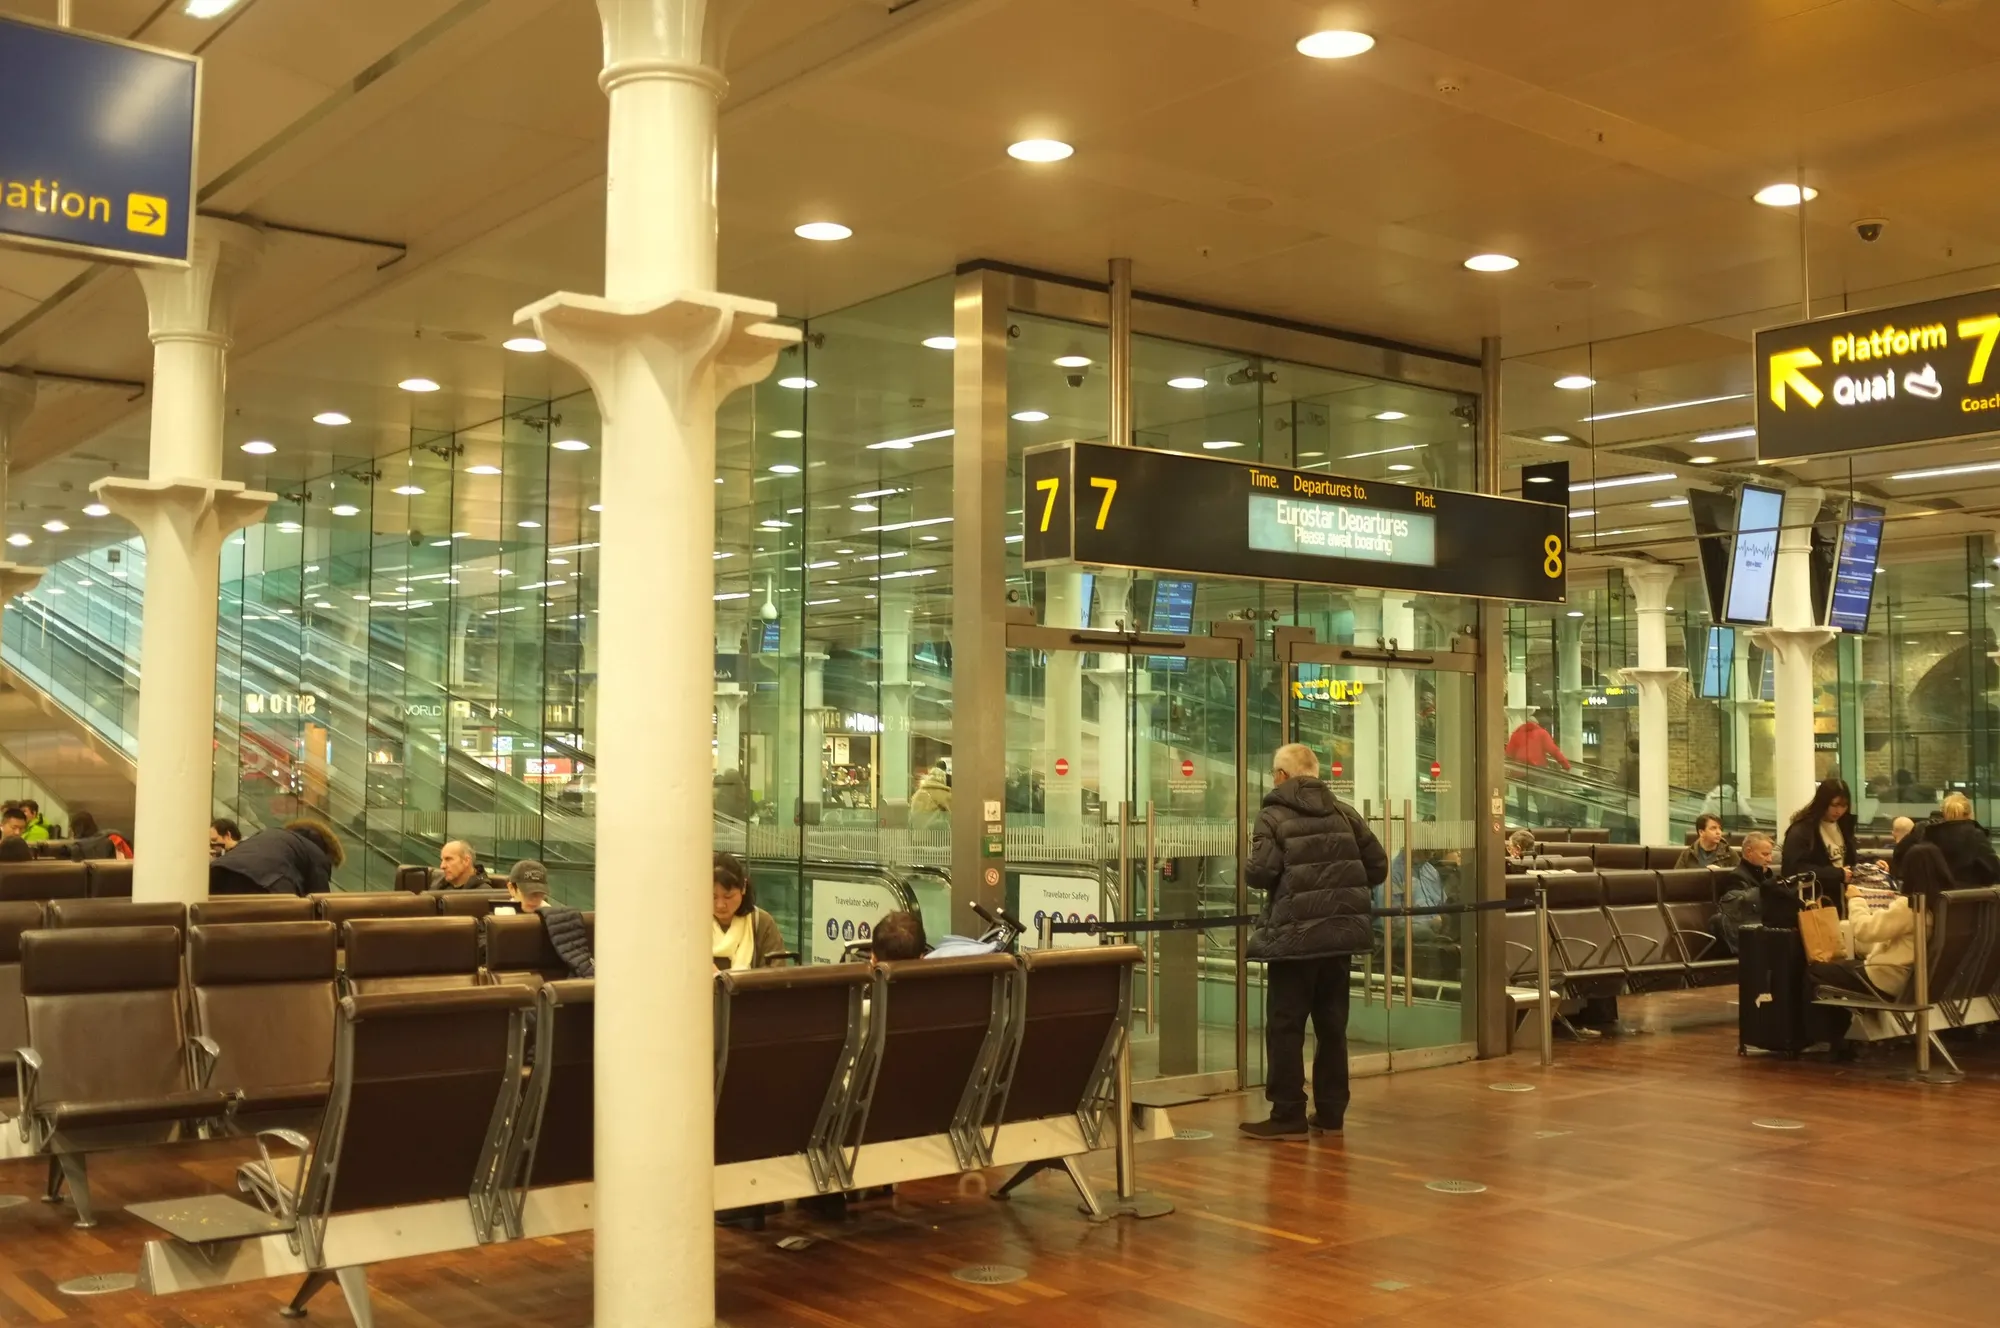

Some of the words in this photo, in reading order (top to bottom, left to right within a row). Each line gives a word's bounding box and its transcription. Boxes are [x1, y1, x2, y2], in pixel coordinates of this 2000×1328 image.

[0, 179, 110, 223] ation
[1832, 322, 1948, 365] Platform
[1957, 312, 2000, 385] 7
[1833, 367, 1896, 407] Quai
[1036, 477, 1060, 533] 7
[1090, 476, 1118, 531] 7
[1250, 469, 1280, 489] Time.
[1293, 475, 1352, 498] Departures
[1354, 484, 1368, 500] to.
[1415, 491, 1437, 509] Plat.
[1276, 499, 1335, 528] Eurostar
[1338, 507, 1409, 537] Departures
[1294, 525, 1325, 546] Please
[1327, 531, 1353, 549] await
[1354, 532, 1393, 556] boarding
[1543, 534, 1563, 579] 8
[834, 895, 862, 908] Travelator
[862, 898, 880, 910] Safety
[1043, 889, 1071, 900] Travelator
[1071, 891, 1091, 902] Safety
